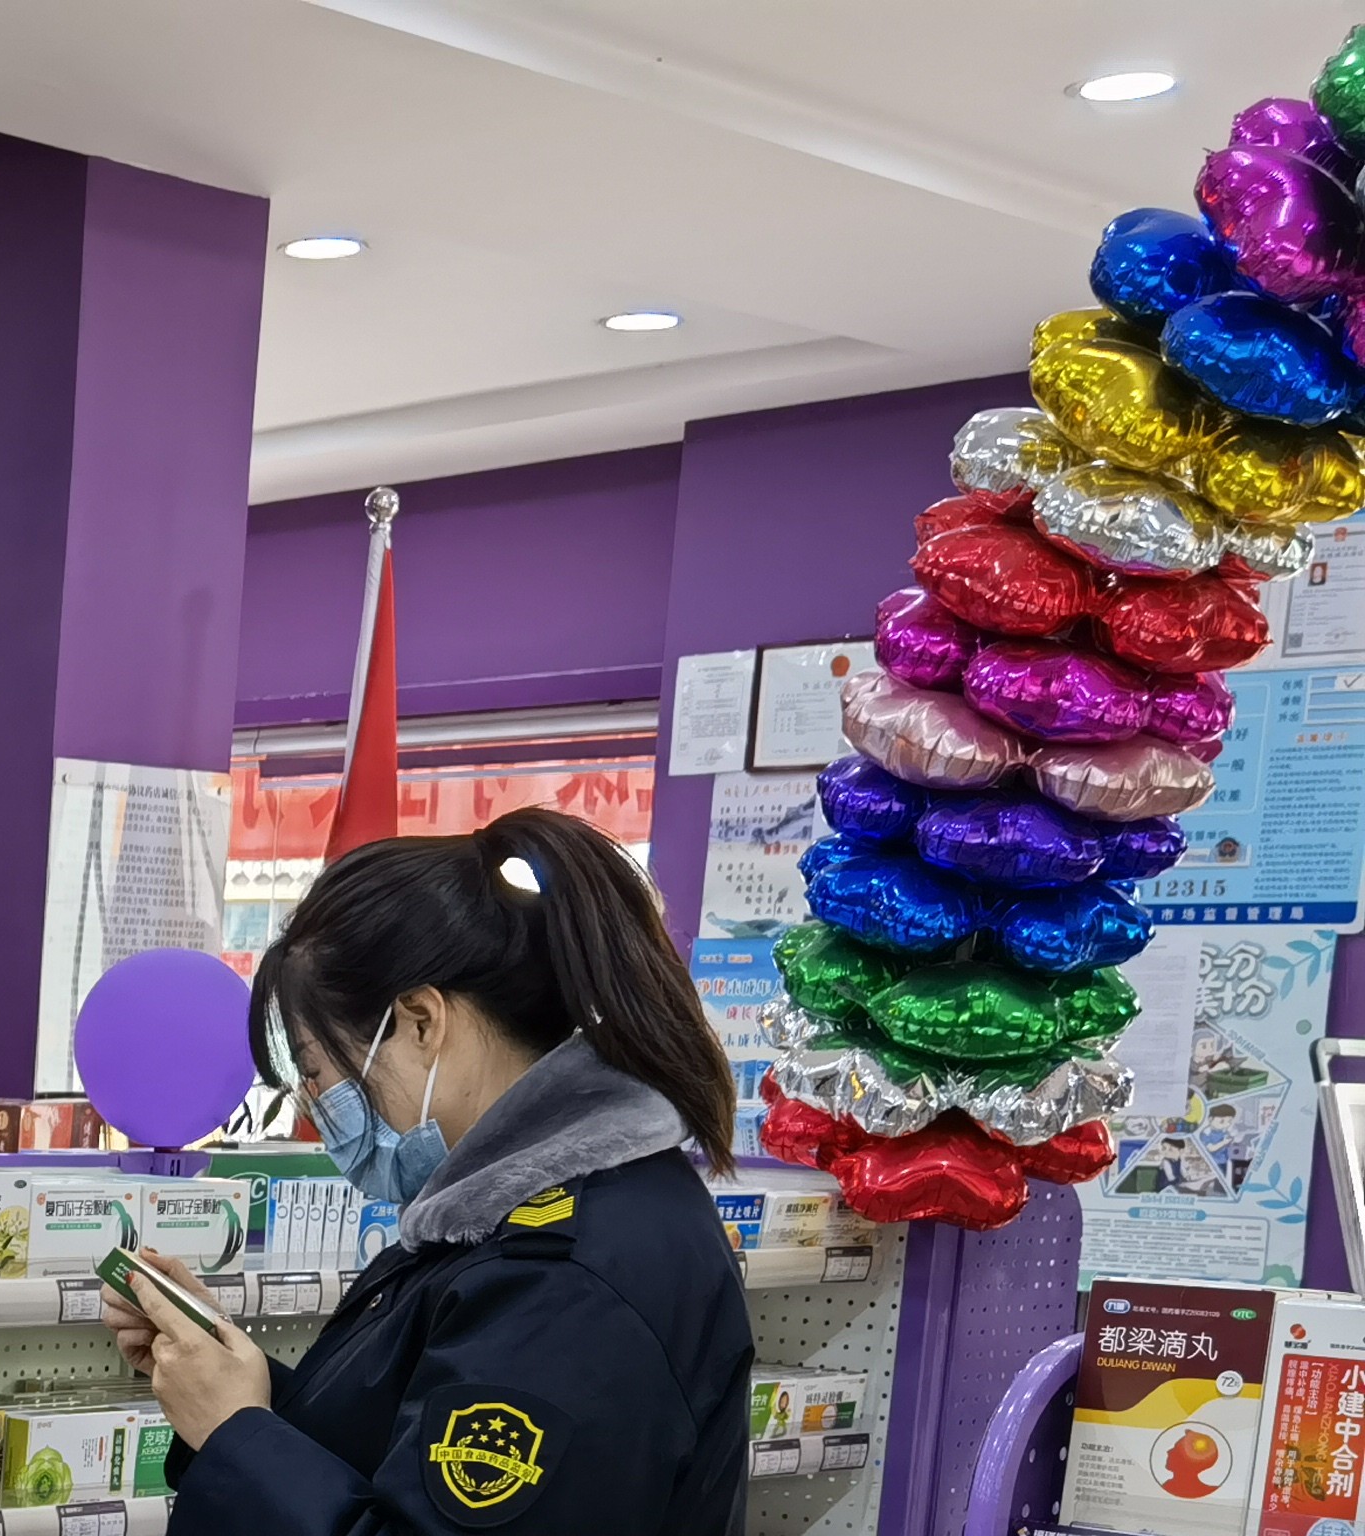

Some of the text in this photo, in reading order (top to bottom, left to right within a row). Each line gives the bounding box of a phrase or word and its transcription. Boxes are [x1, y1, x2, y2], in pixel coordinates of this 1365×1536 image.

[1153, 878, 1227, 897] 12315
[1232, 1309, 1255, 1319] OTC
[1097, 1324, 1219, 1362] 都梁滴丸
[1096, 1356, 1177, 1373] DULIANG DIWAN
[1326, 1364, 1365, 1499] 小建中合剂
